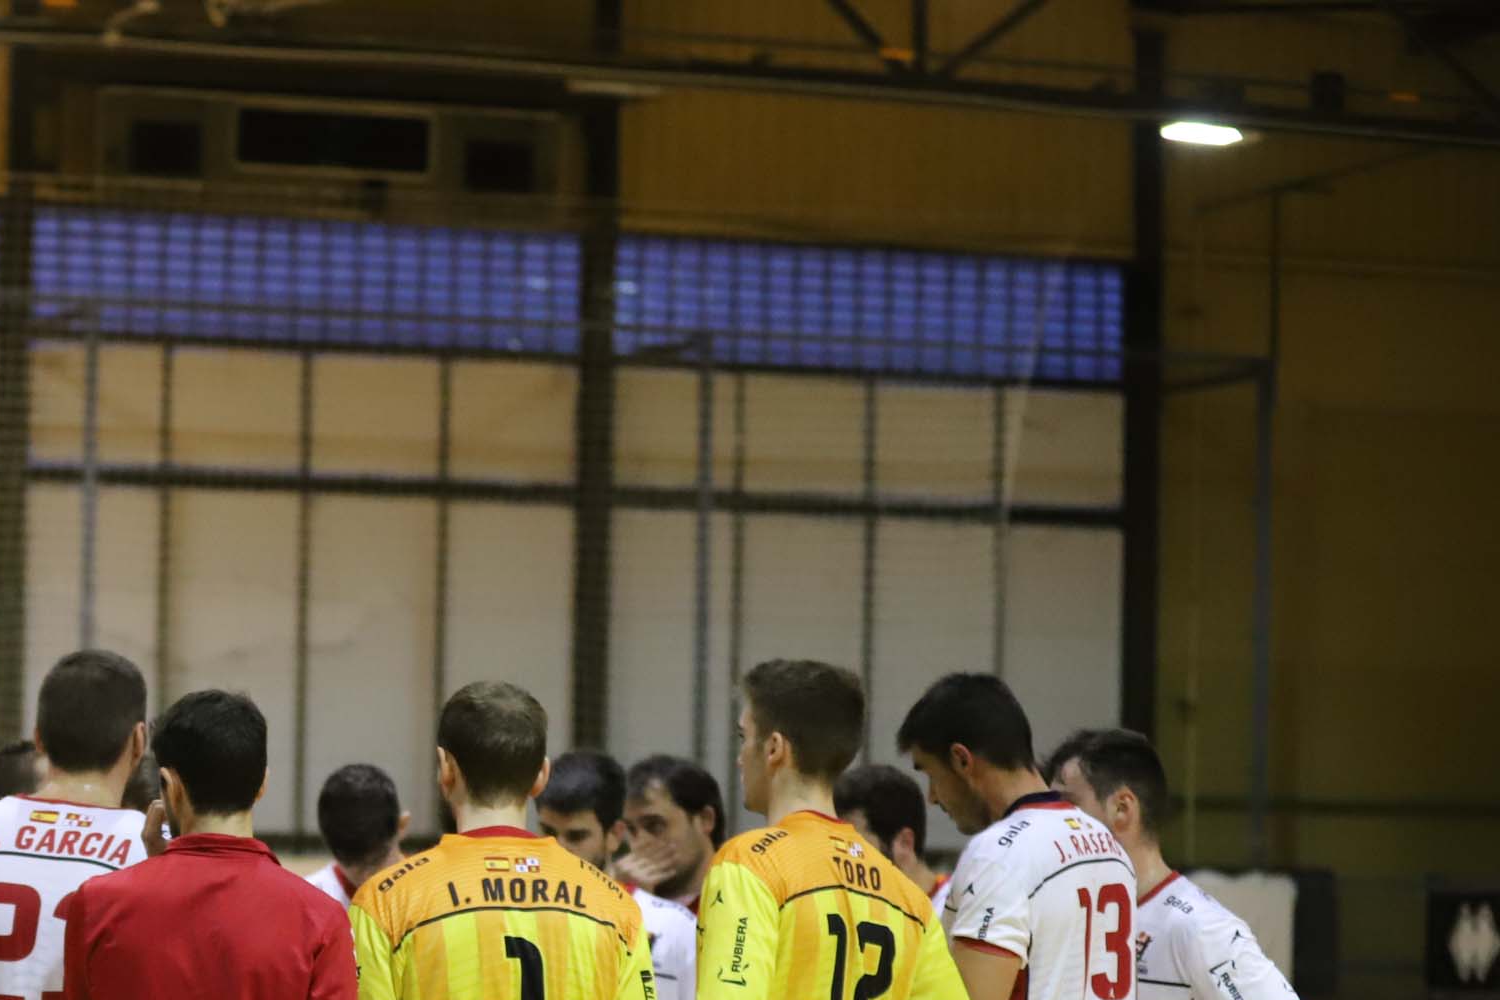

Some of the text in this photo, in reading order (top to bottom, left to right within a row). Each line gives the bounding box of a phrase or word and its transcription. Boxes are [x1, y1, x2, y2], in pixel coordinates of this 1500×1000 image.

[14, 824, 133, 866] GARCIA
[750, 829, 789, 856] gala
[998, 819, 1031, 849] gala
[1053, 839, 1072, 864] J.
[377, 855, 431, 893] gala
[832, 855, 882, 891] TORO
[446, 880, 472, 907] I.
[480, 876, 587, 909] MORAL
[1163, 894, 1194, 915] gala
[730, 916, 749, 974] RUBIERA
